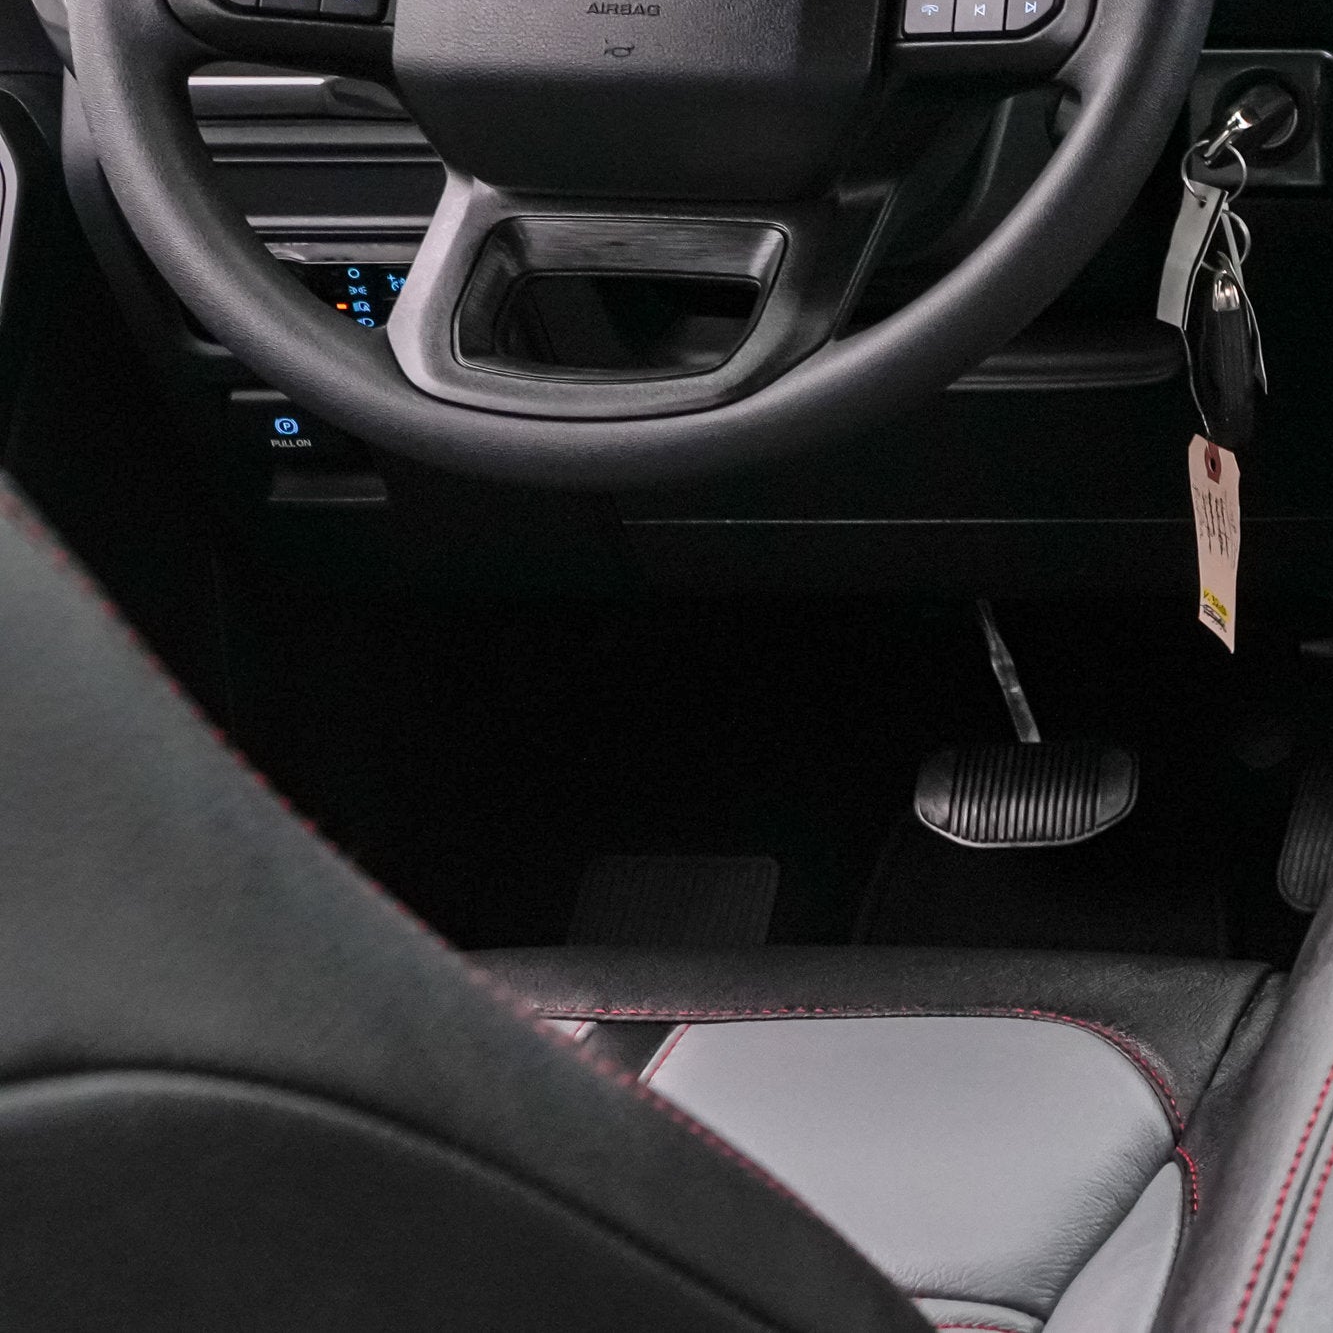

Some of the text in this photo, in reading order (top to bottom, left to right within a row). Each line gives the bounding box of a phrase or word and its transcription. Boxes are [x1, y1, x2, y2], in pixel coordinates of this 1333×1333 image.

[587, 2, 661, 16] AIRBAG
[270, 438, 312, 448] PULL ON
